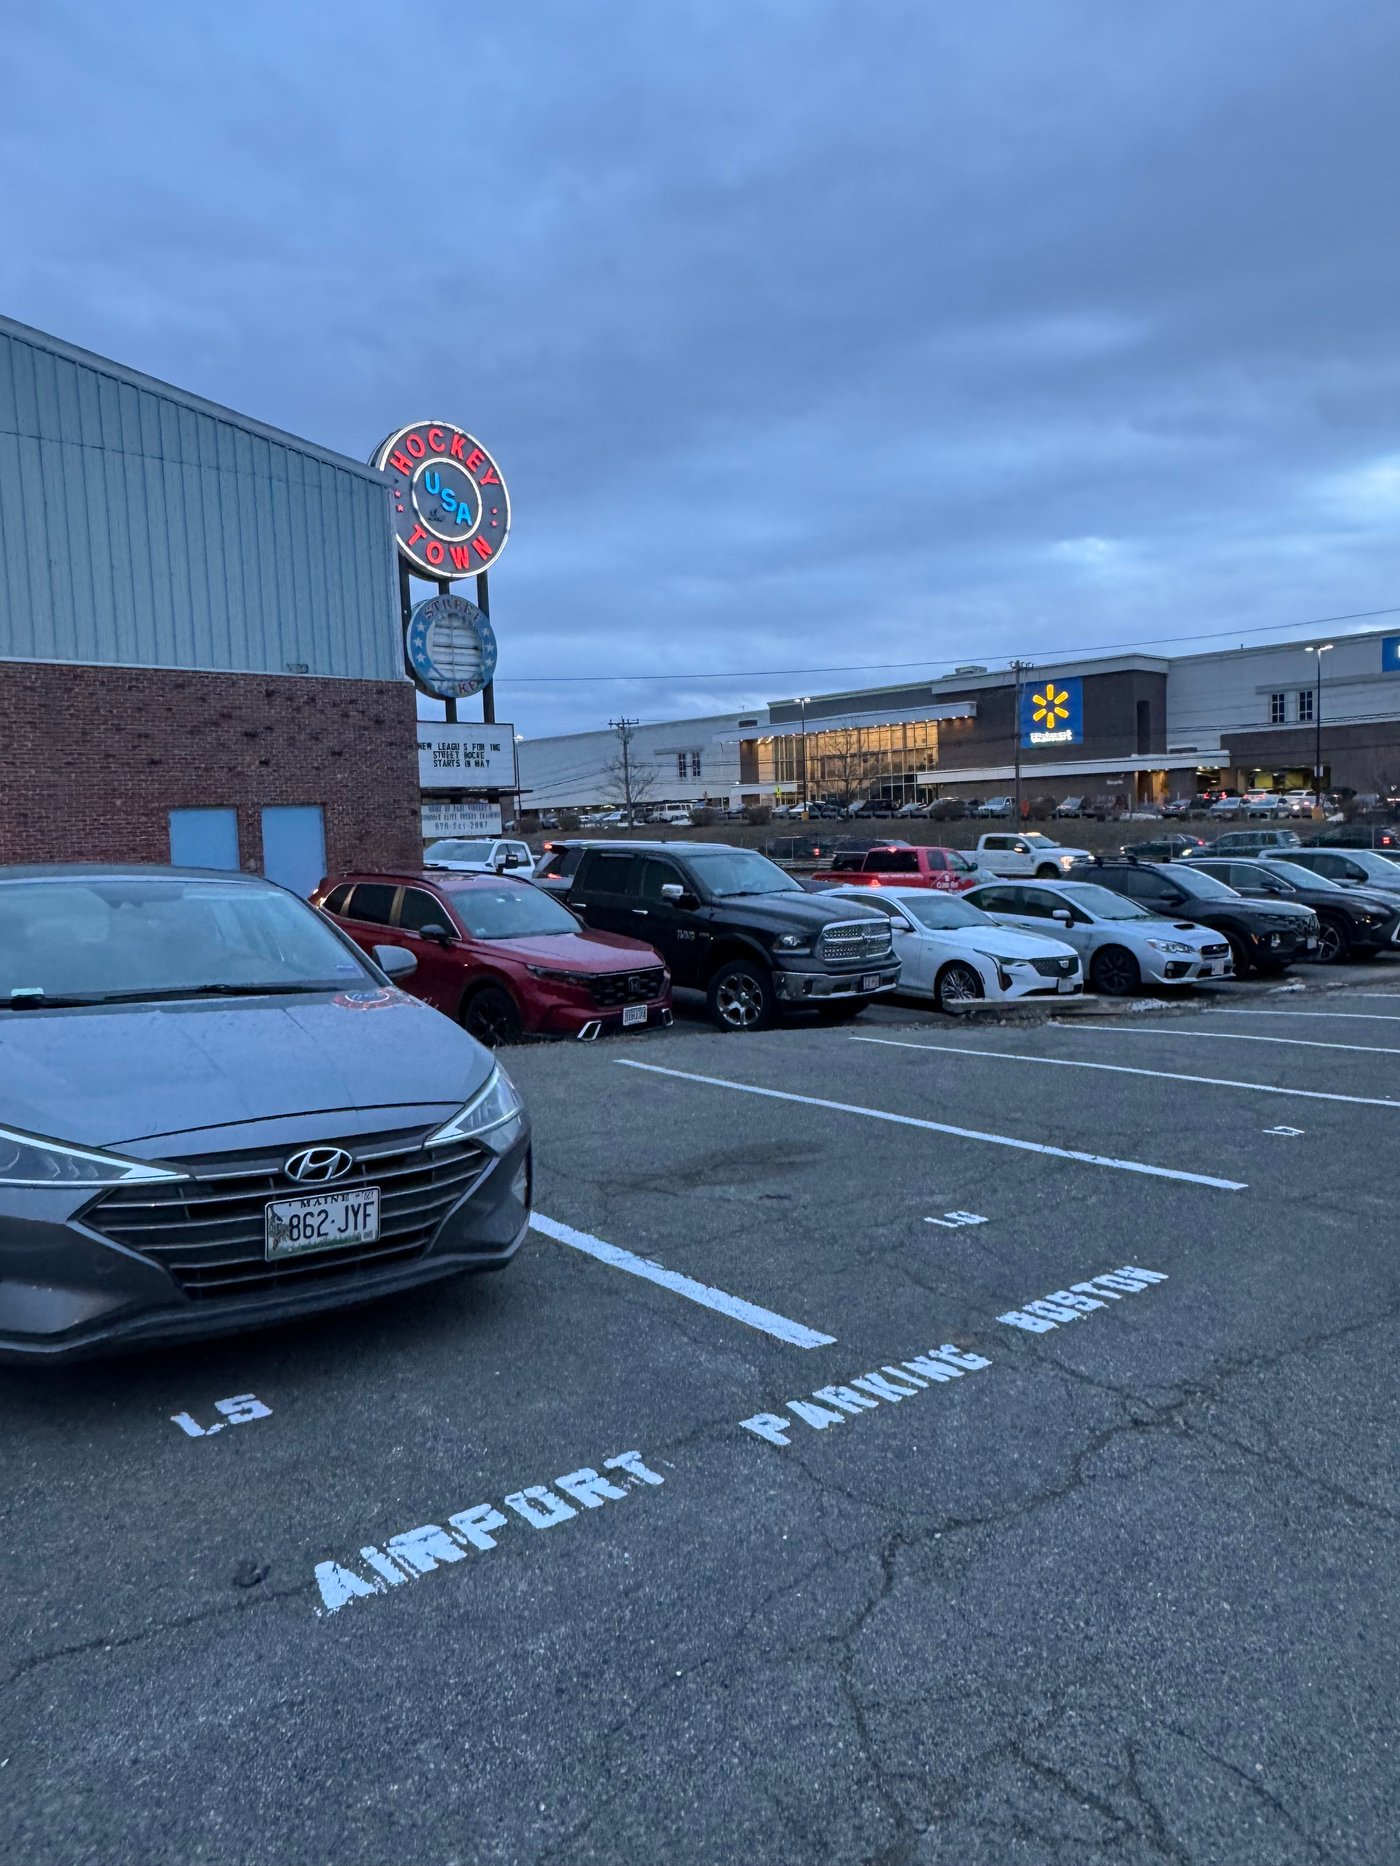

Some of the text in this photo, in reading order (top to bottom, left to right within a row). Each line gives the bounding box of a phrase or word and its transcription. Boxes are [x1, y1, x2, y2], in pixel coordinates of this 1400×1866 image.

[389, 427, 500, 486] HOCKEY
[424, 470, 473, 526] USA
[408, 523, 493, 570] TOWN
[433, 759, 460, 768] STARTS
[472, 742, 485, 751] FOR
[314, 1265, 1169, 1611] AIRPORT PARKING BOSTON
